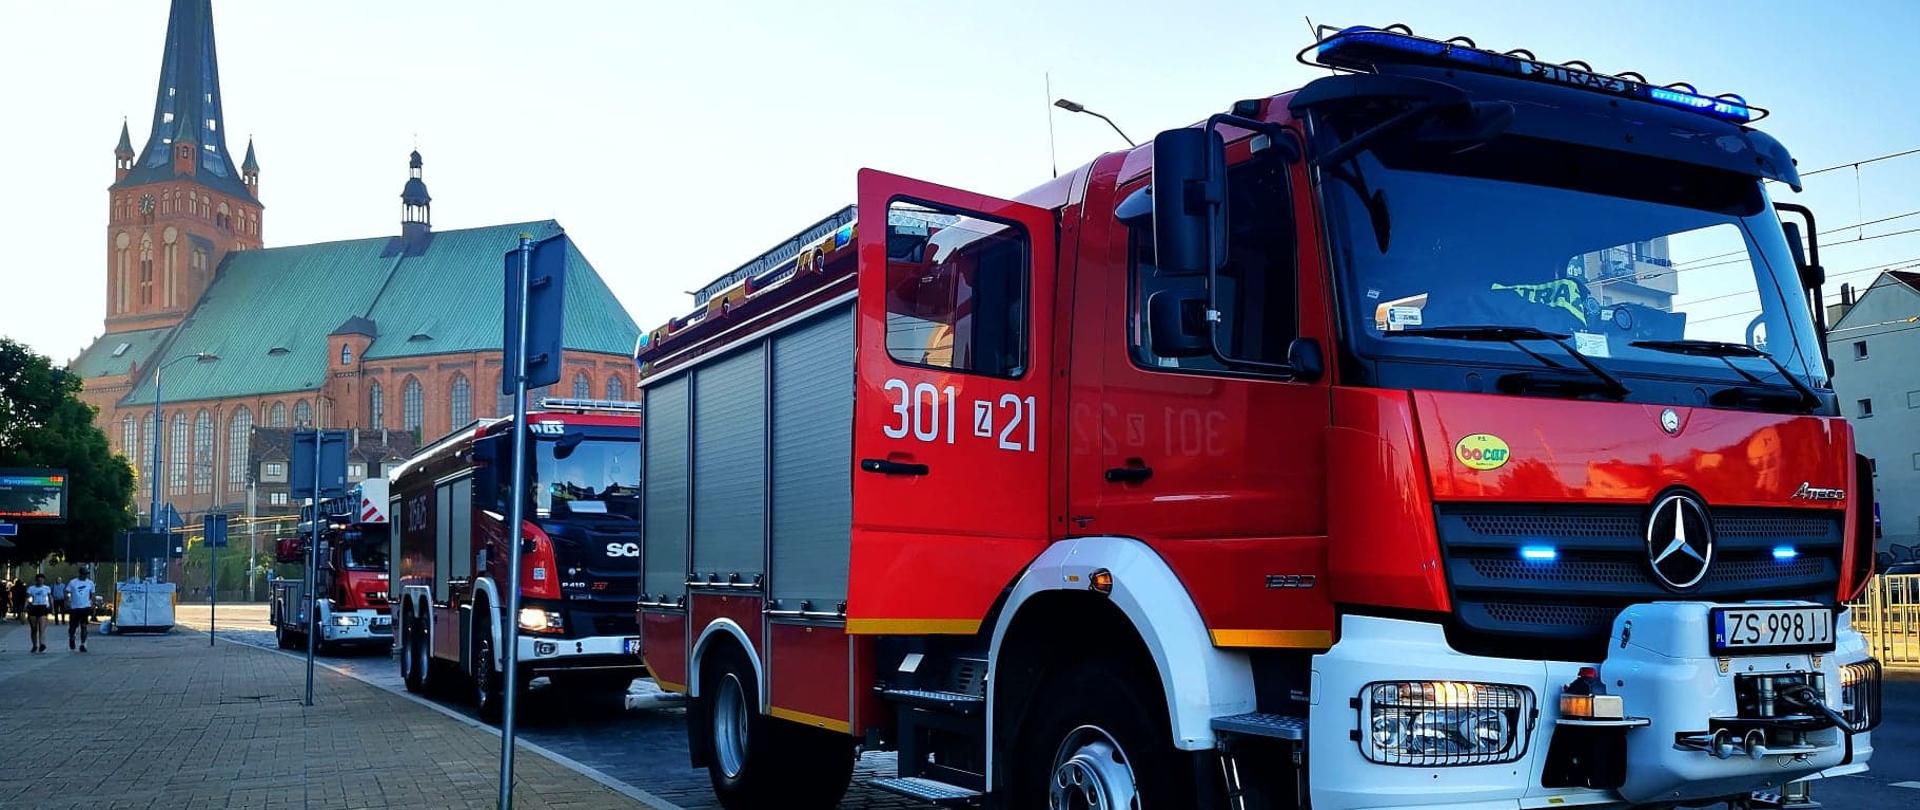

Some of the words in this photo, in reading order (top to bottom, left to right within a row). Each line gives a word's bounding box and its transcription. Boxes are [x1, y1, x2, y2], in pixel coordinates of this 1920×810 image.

[883, 378, 955, 444] 301
[976, 402, 991, 435] Z
[999, 393, 1036, 452] 21
[1461, 444, 1507, 461] bocar
[606, 542, 640, 558] SC
[1729, 613, 1761, 645] ZS
[1768, 611, 1828, 644] 998JJ
[1716, 633, 1725, 643] PL
